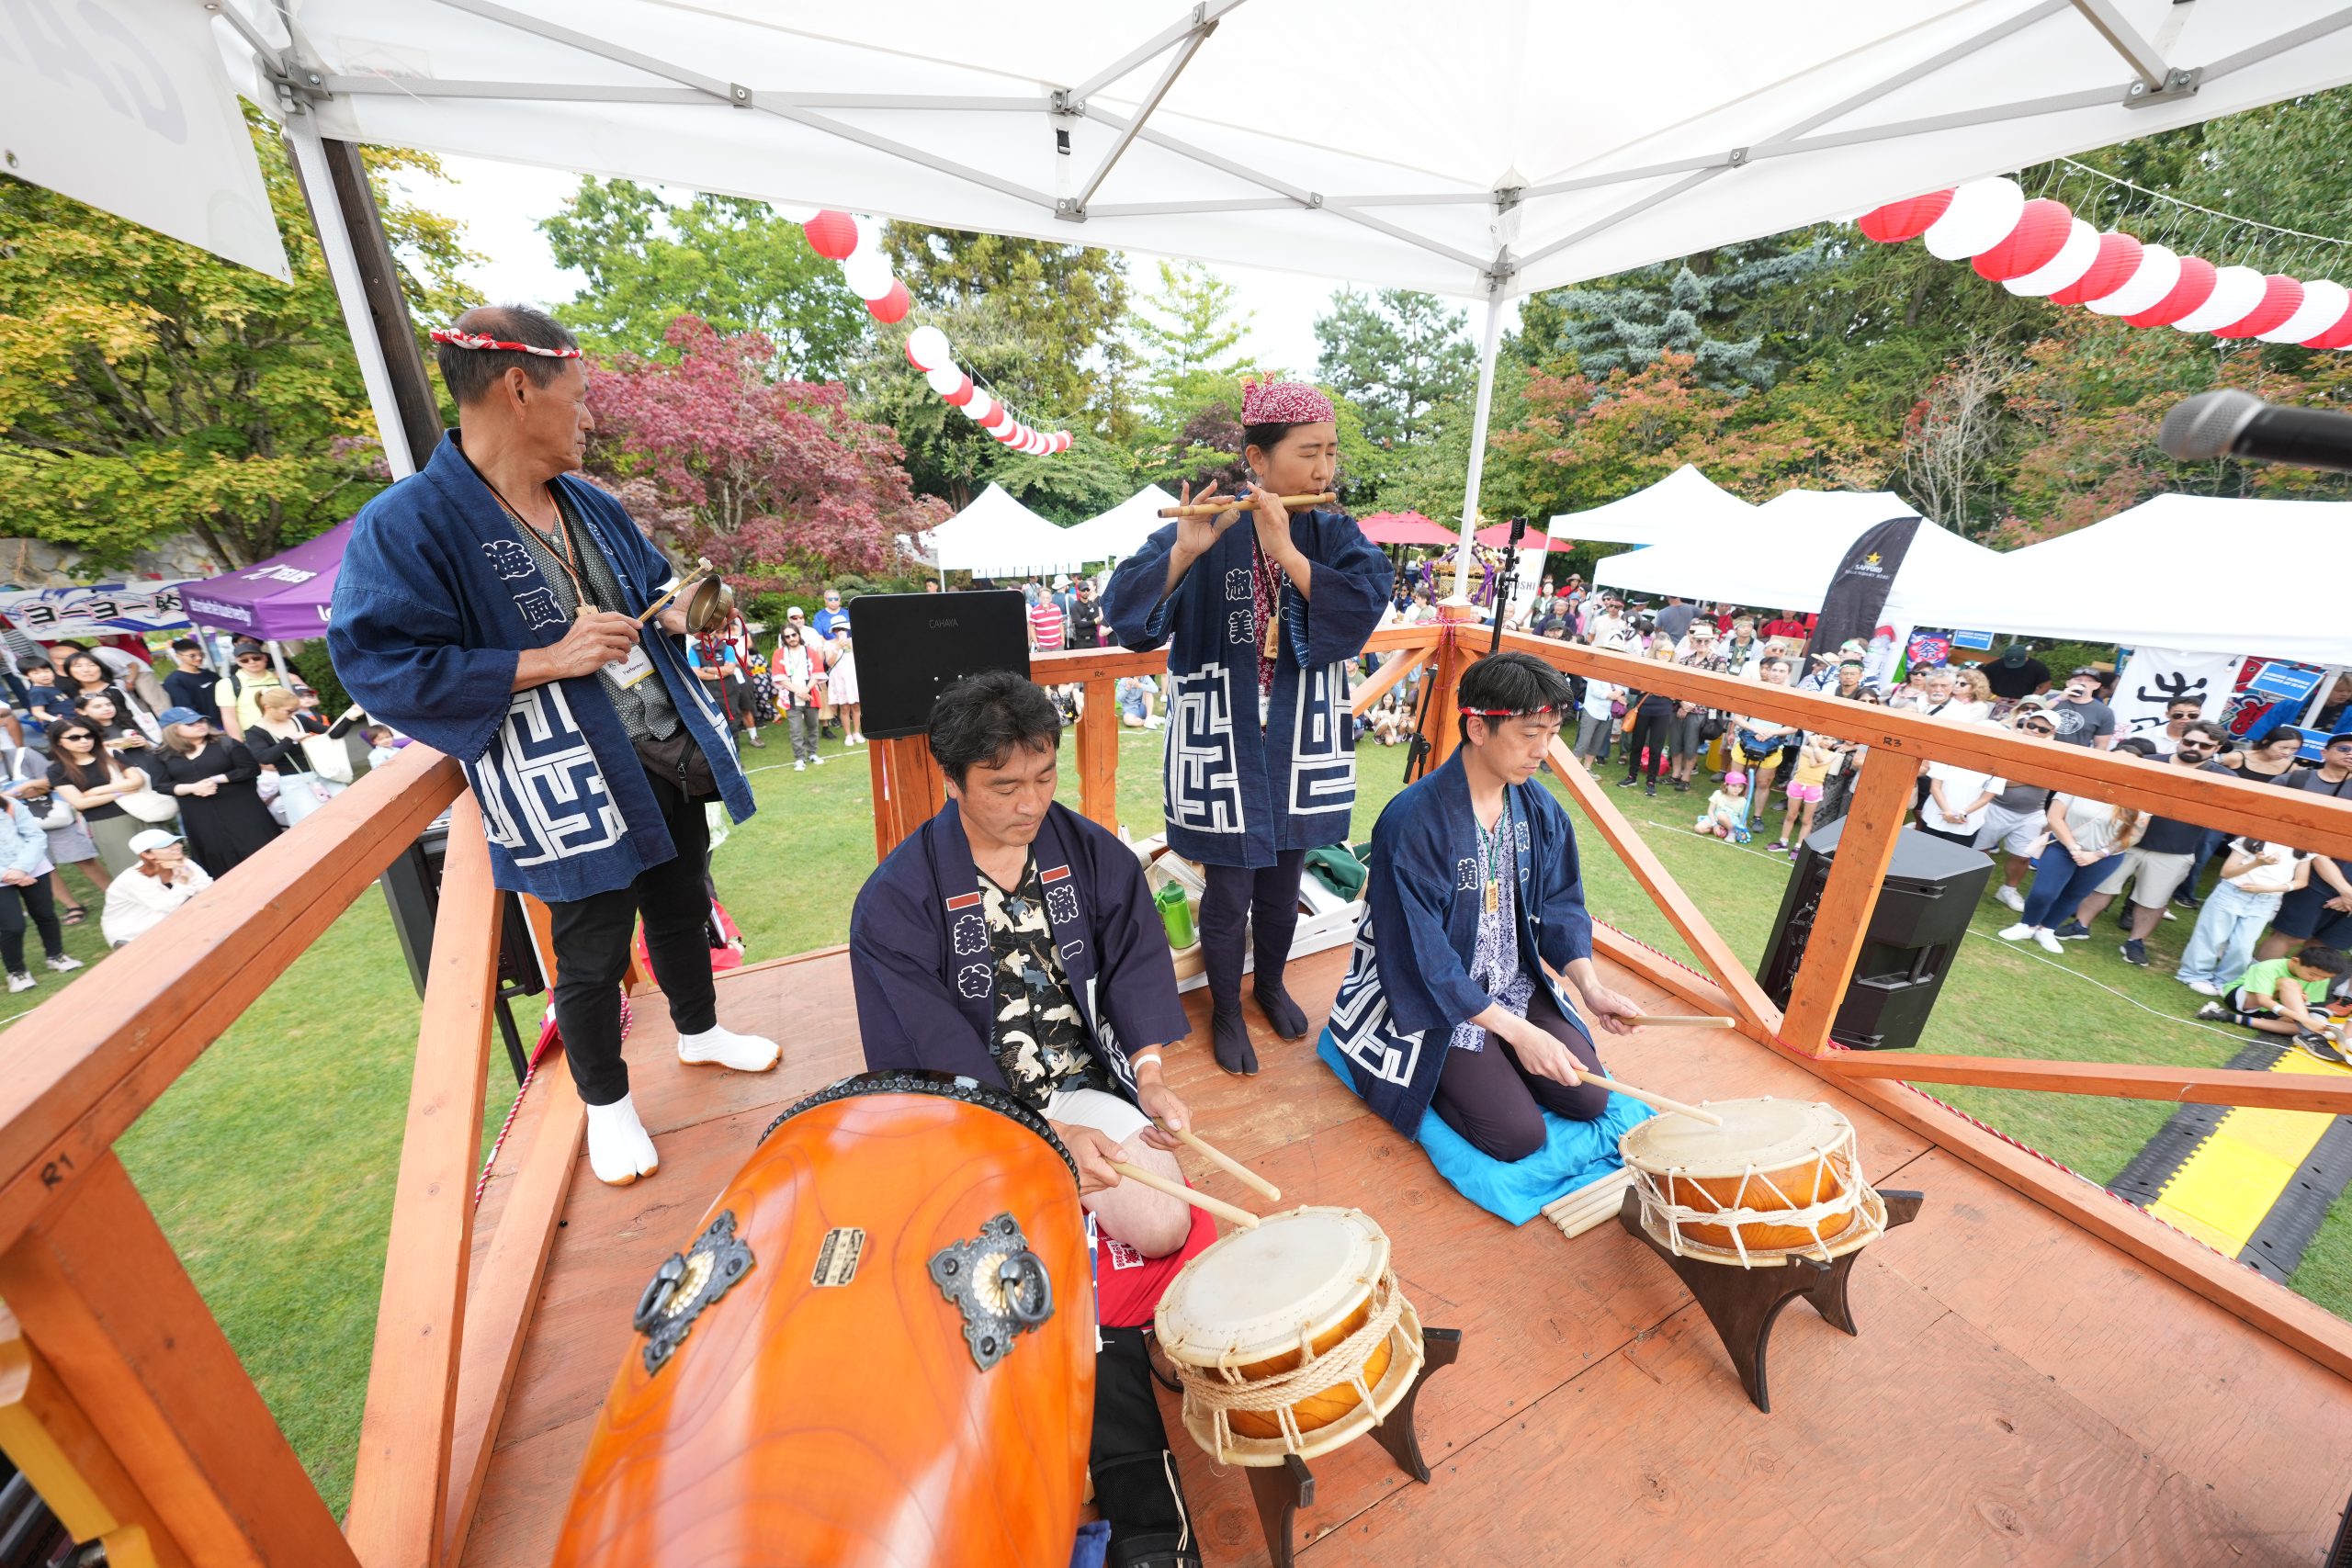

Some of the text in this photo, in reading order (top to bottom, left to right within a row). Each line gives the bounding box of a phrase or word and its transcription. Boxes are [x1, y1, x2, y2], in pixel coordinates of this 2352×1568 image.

[1855, 564, 1883, 573] SAPPORO
[928, 617, 959, 629] CAHAYA
[1917, 640, 1941, 659] 祭
[1883, 736, 1902, 748] R3
[40, 1151, 74, 1192] R1
